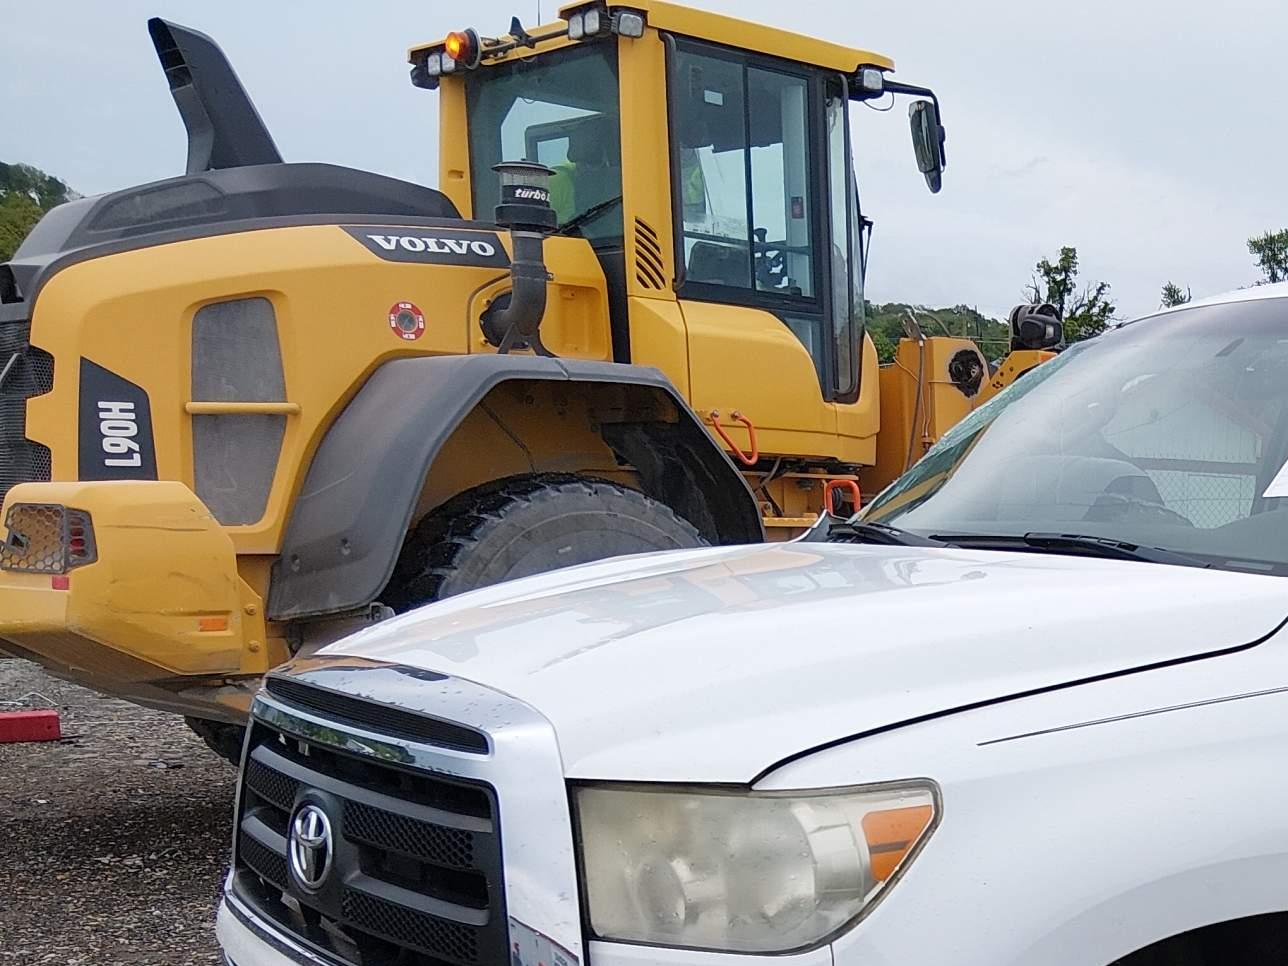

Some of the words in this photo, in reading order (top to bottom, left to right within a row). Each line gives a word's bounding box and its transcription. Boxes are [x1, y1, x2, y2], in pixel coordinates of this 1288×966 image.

[514, 188, 546, 201] turbo
[367, 235, 495, 256] VOLVO
[97, 401, 142, 467] L90H
